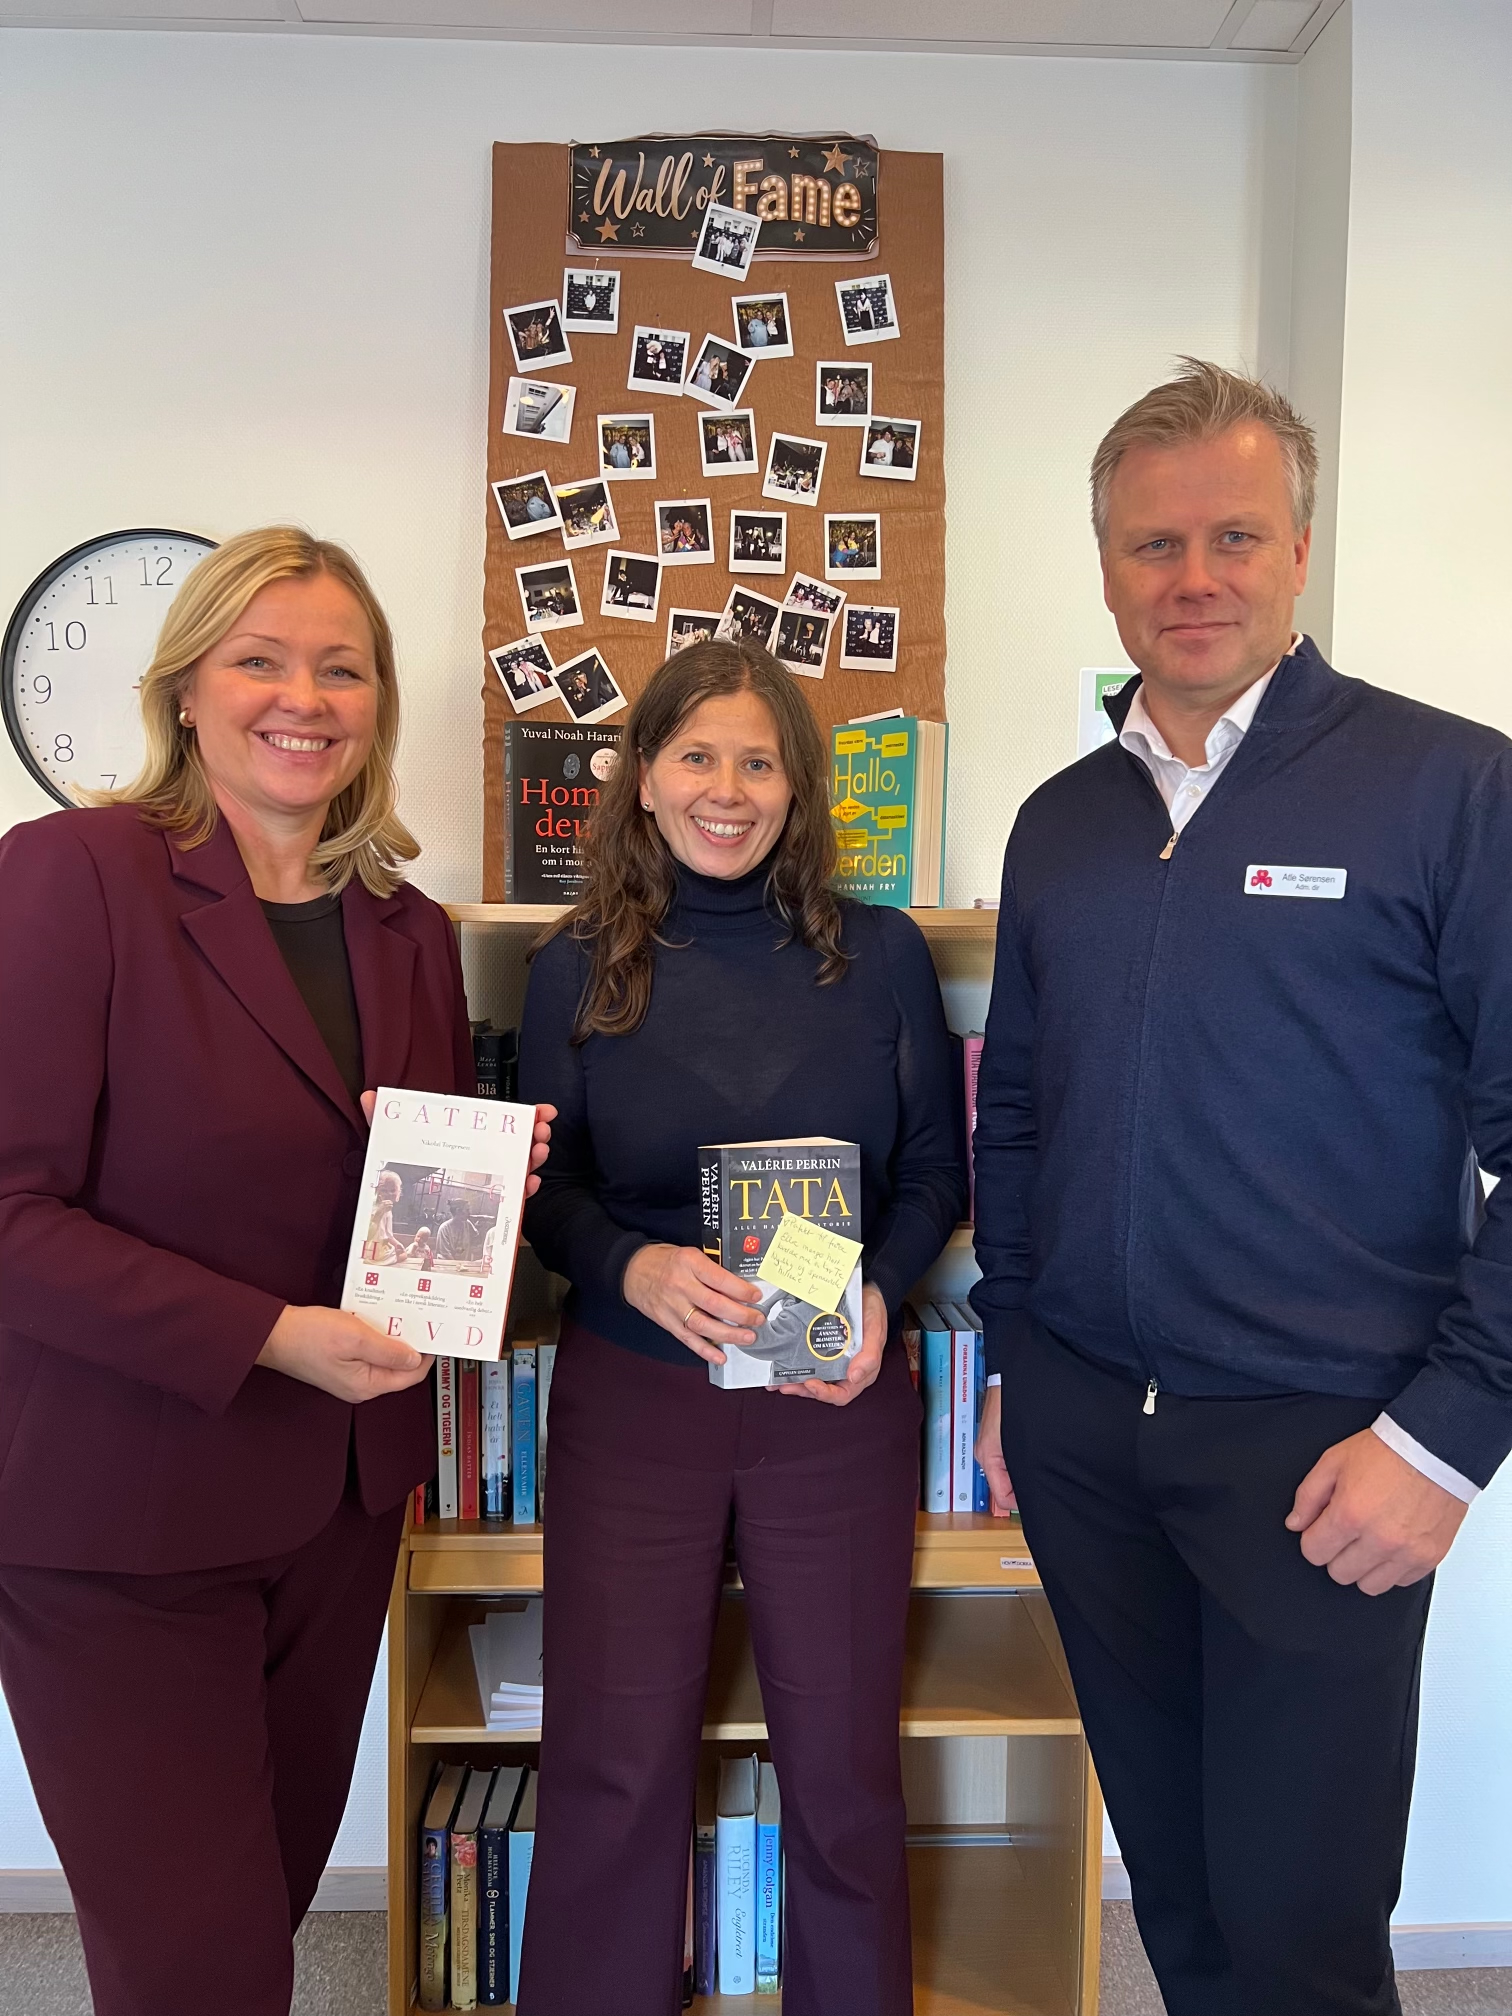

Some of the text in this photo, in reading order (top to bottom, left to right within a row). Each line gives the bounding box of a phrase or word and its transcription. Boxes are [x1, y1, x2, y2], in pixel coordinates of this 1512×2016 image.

[593, 151, 862, 228] Wall of Fame
[139, 556, 174, 587] 12
[84, 576, 119, 606] 11
[45, 619, 87, 651] 10
[33, 674, 52, 704] 9
[54, 733, 74, 763] 8
[521, 728, 552, 739] Yuval
[554, 729, 584, 741] Noah
[587, 731, 622, 742] Harari
[519, 778, 600, 807] Hom
[834, 758, 901, 796] Hallo,
[535, 808, 592, 838] deu
[535, 844, 548, 853] En
[550, 845, 570, 854] kort
[542, 858, 557, 866] om
[832, 841, 906, 877] erden
[837, 883, 896, 891] HANNAH FRY
[1298, 873, 1336, 884] Sørensen
[477, 1082, 497, 1095] Blå
[384, 1100, 517, 1135] GATER
[740, 1157, 841, 1171] VALÉRIE PERRIN
[701, 1167, 712, 1227] PERRIN
[710, 1162, 720, 1230] VALÉRIE
[730, 1177, 853, 1220] TATA
[441, 1356, 452, 1456] TOMMY OG TIGERN 5
[516, 1382, 532, 1443] GAVEN
[727, 1844, 742, 1899] RILEY
[741, 1848, 750, 1894] LUCINDA
[763, 1834, 776, 1908] Jenny Colgan
[430, 1863, 442, 1926] CECILIA
[463, 1874, 471, 1903] Monika
[461, 1910, 470, 1987] TIRSDAGSDAMENE
[489, 1947, 495, 1958] OG
